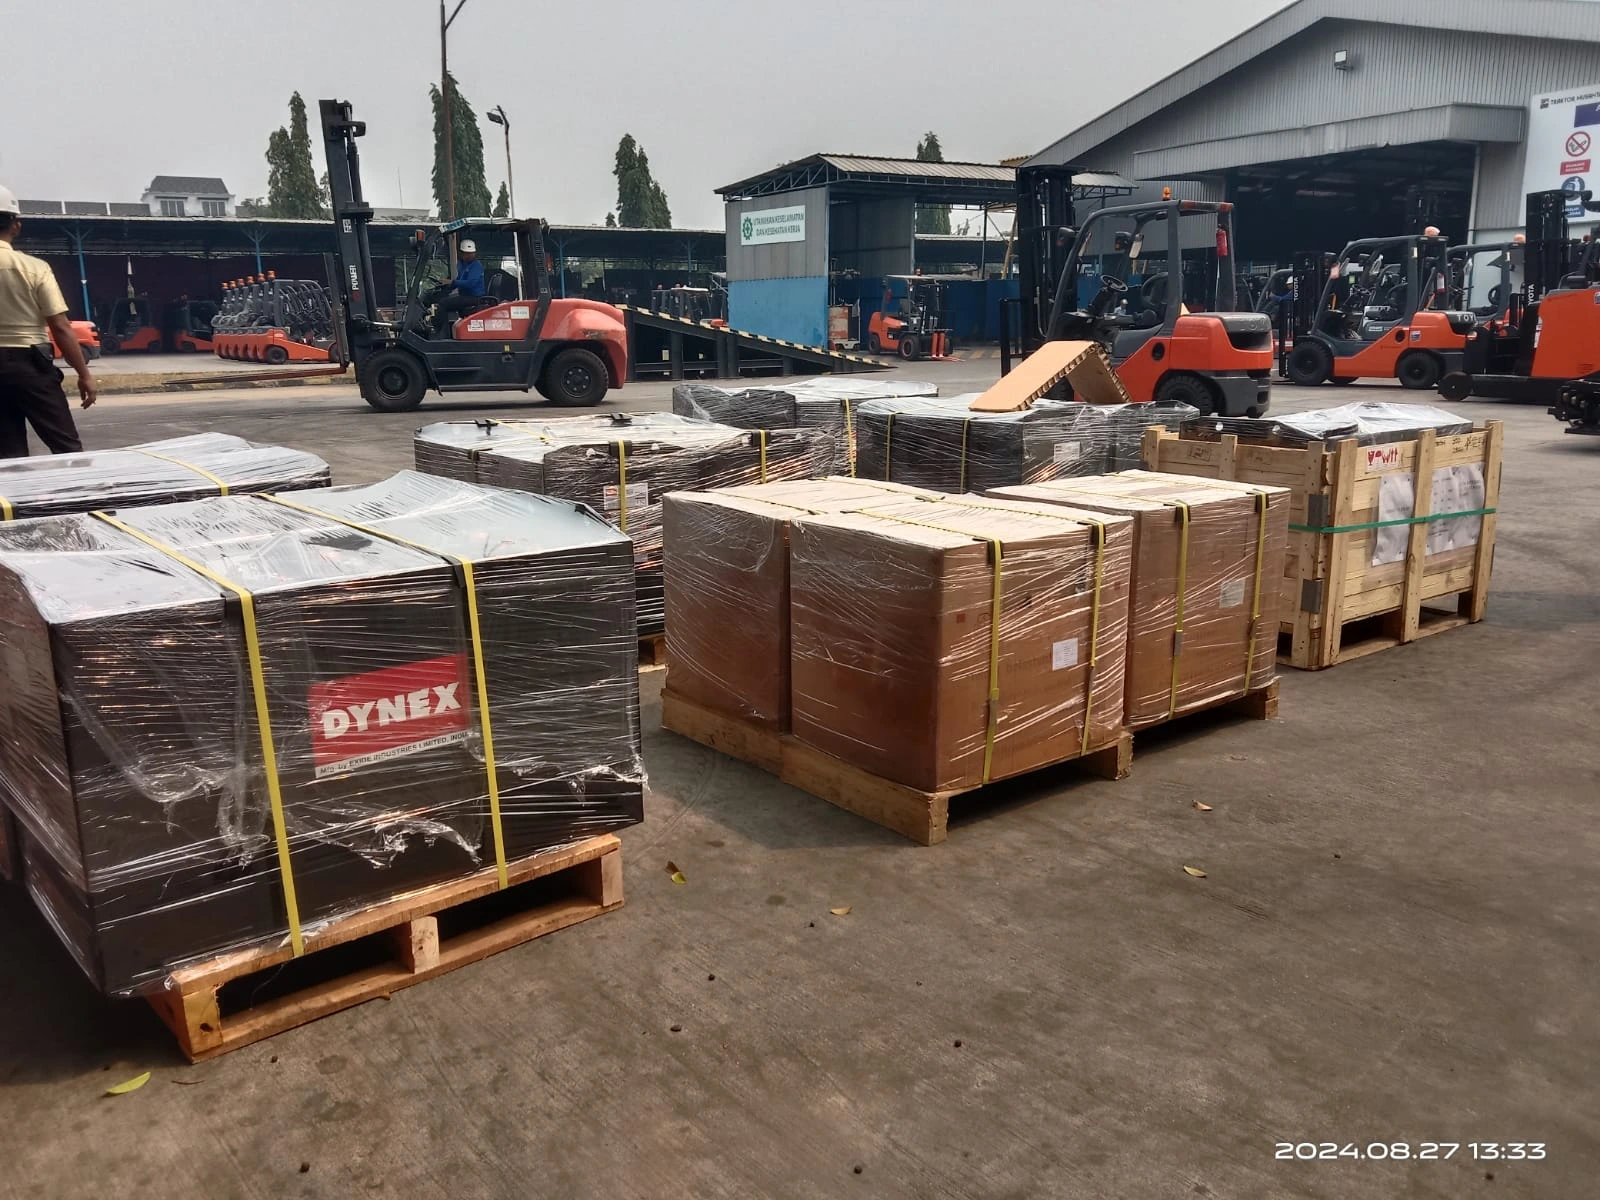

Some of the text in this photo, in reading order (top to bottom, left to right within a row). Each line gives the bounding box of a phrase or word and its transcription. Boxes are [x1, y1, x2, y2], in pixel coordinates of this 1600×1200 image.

[322, 682, 461, 739] DYNEX
[349, 757, 372, 767] EXIDE
[373, 744, 417, 760] INDUSTRIES
